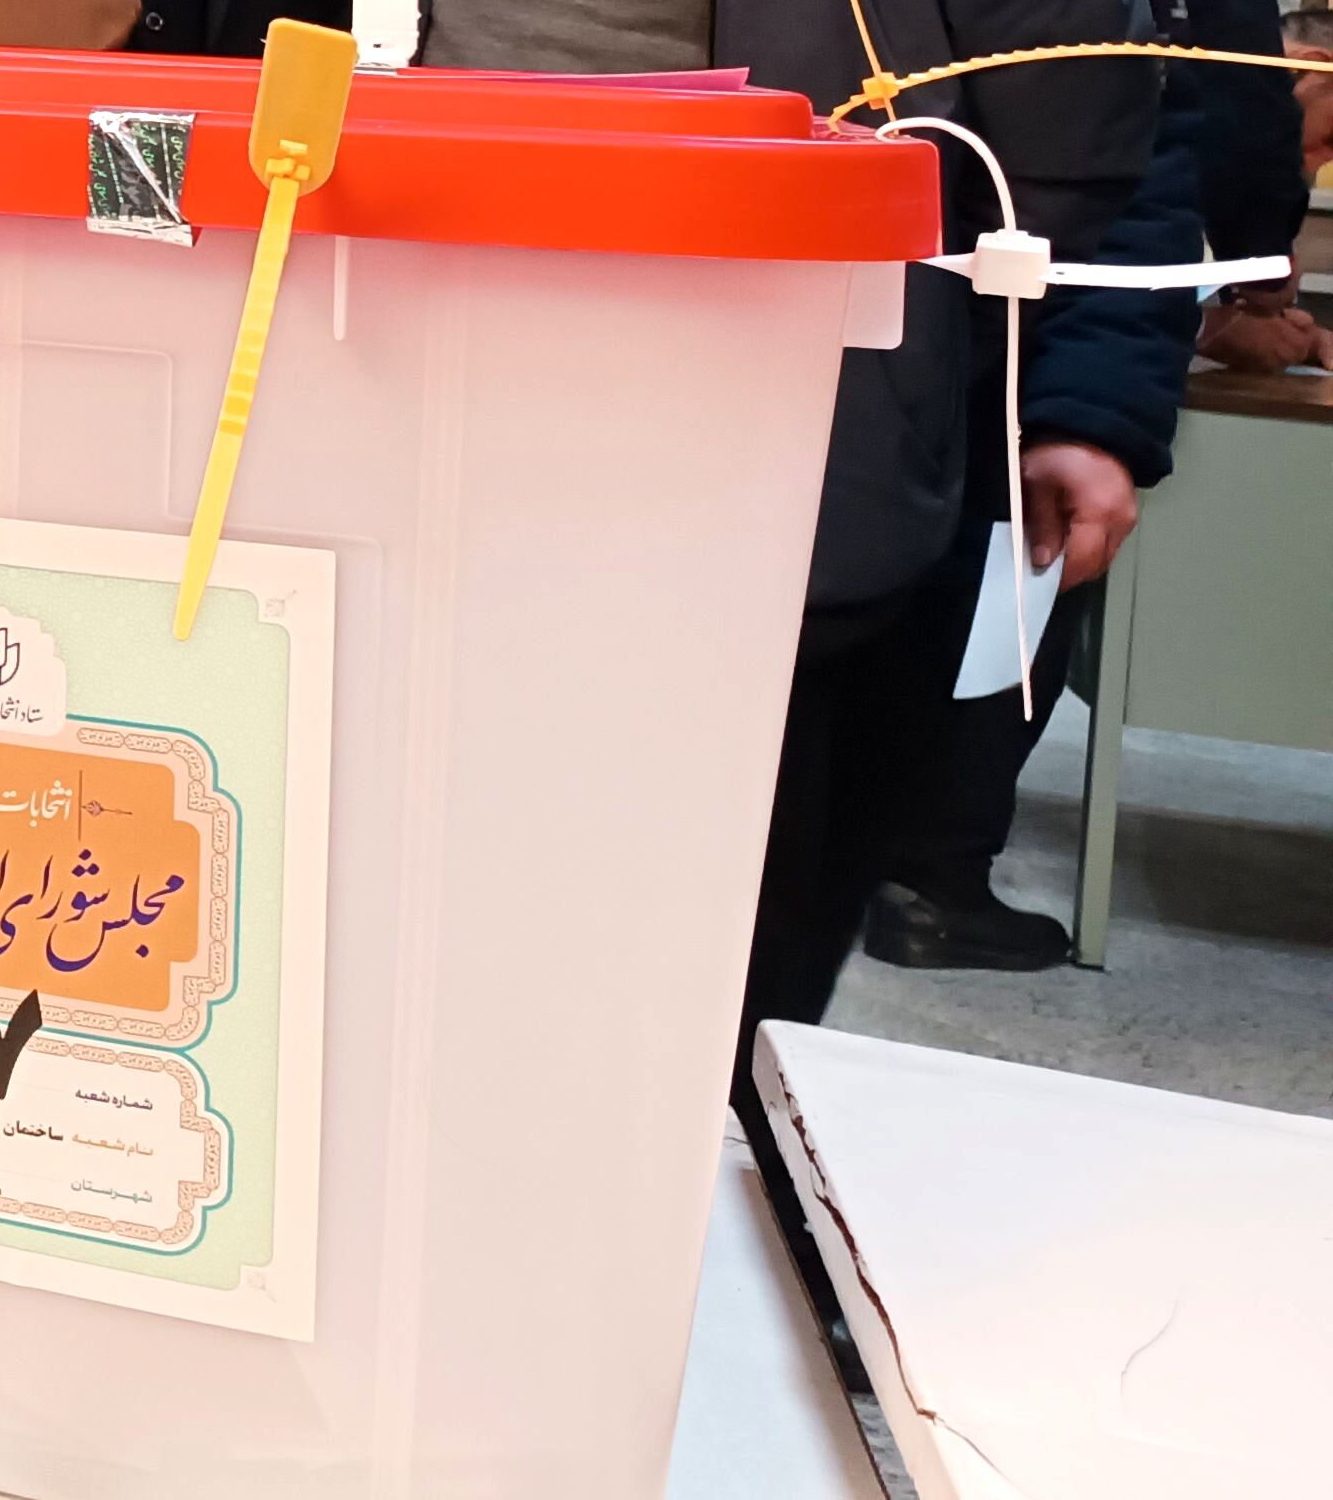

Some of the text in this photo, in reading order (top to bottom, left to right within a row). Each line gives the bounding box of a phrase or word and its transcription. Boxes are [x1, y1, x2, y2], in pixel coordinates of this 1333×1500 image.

[20, 704, 43, 723] ستاد
[45, 874, 185, 973] مجلس
[74, 1089, 154, 1111] شماره شعبه
[3, 1121, 64, 1141] ساختمان
[71, 1133, 154, 1157] نام شعبه
[70, 1179, 153, 1204] شهرستان
